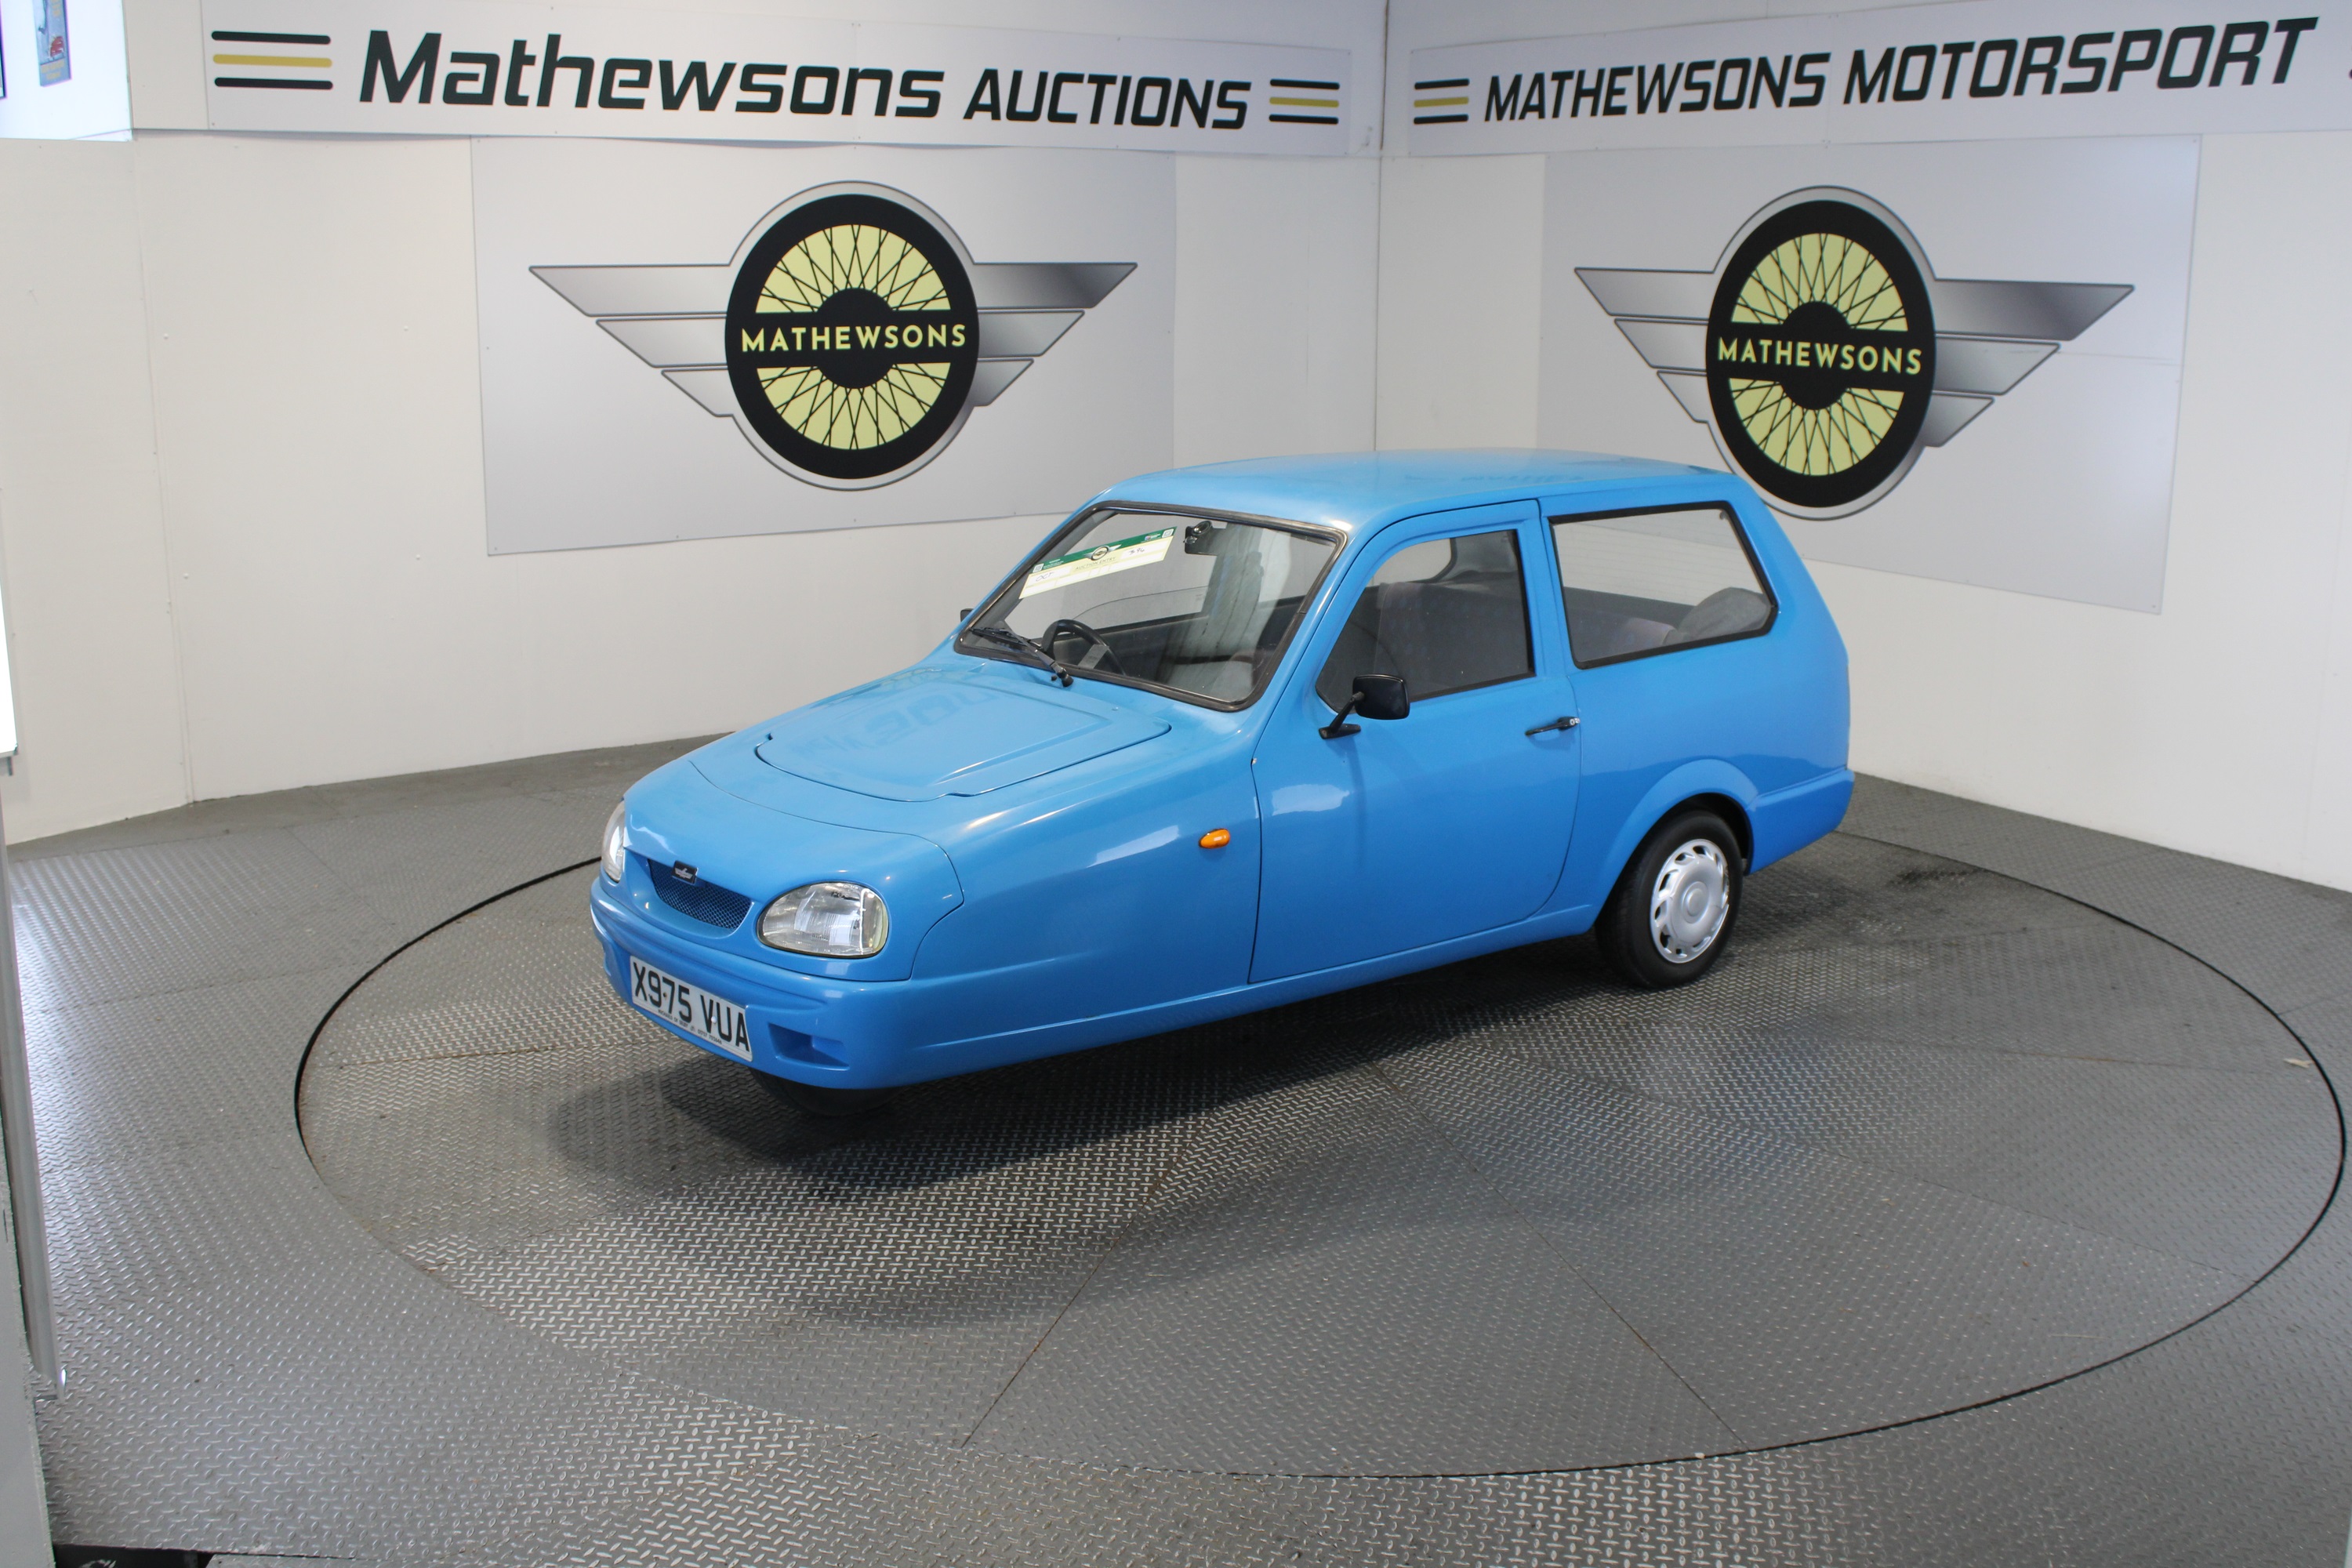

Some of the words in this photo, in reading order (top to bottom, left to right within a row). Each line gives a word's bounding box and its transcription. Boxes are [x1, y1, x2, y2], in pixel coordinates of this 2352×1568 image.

[360, 30, 944, 118] Mathewsons
[963, 68, 1252, 129] AUCTIONS
[1485, 52, 1831, 122] MATHEWSONS
[1842, 16, 2320, 104] MOTORSPORT
[742, 324, 966, 352] MATHEWSONS
[1718, 336, 1922, 376] MATHEWSONS
[633, 962, 692, 1024] X975
[700, 994, 750, 1052] VUA
